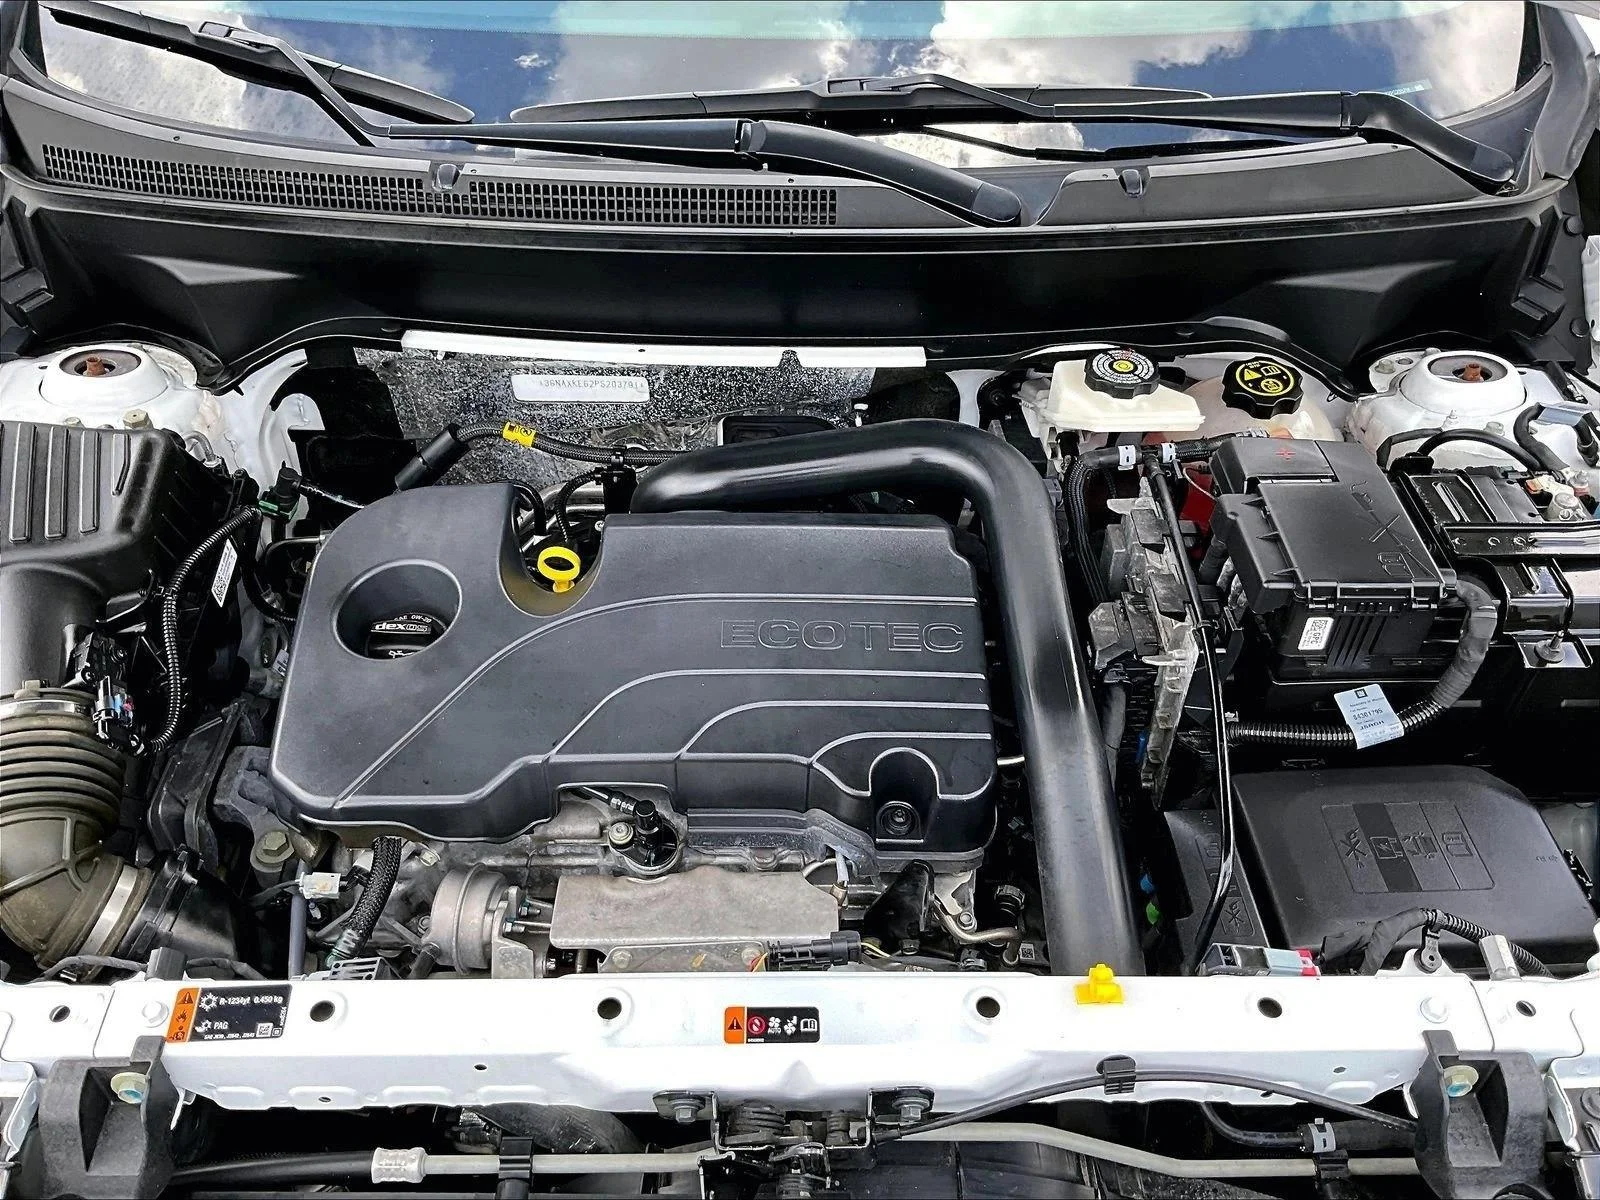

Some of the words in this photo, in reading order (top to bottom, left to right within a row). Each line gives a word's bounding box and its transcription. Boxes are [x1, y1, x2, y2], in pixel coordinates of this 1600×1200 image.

[375, 622, 428, 631] dexos
[720, 618, 964, 653] ECOTEC
[219, 995, 251, 1006] R-1234yf
[253, 995, 273, 1004] 0.450
[273, 995, 283, 1004] kg
[213, 1021, 229, 1030] PAG
